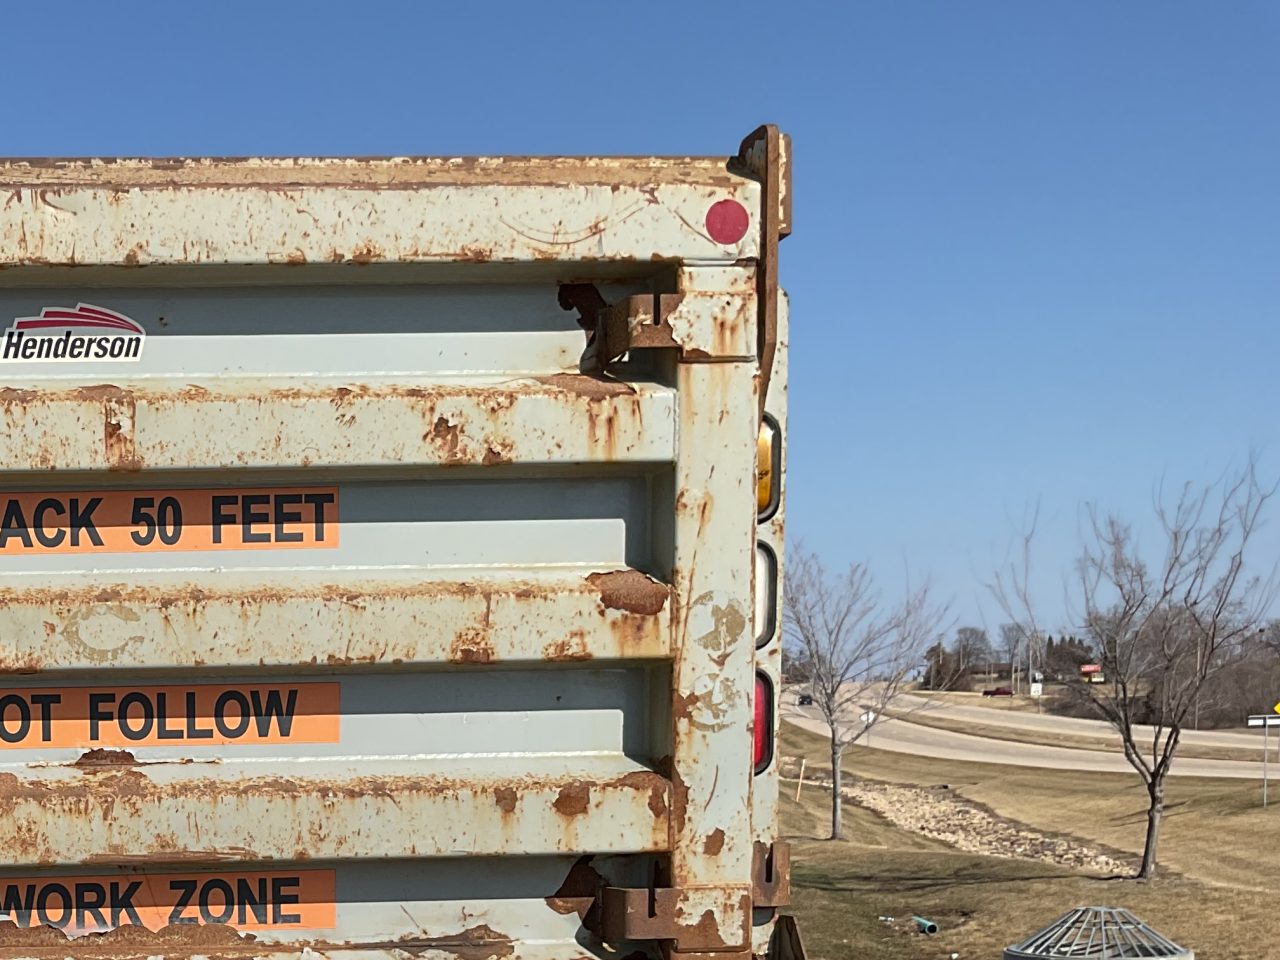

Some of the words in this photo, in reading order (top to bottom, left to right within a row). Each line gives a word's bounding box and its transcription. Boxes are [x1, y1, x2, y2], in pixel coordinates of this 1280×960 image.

[3, 330, 141, 359] Henderson
[131, 497, 182, 545] 50
[212, 493, 334, 543] FEET
[89, 689, 298, 740] FOLLOW
[168, 876, 301, 925] ZONE
